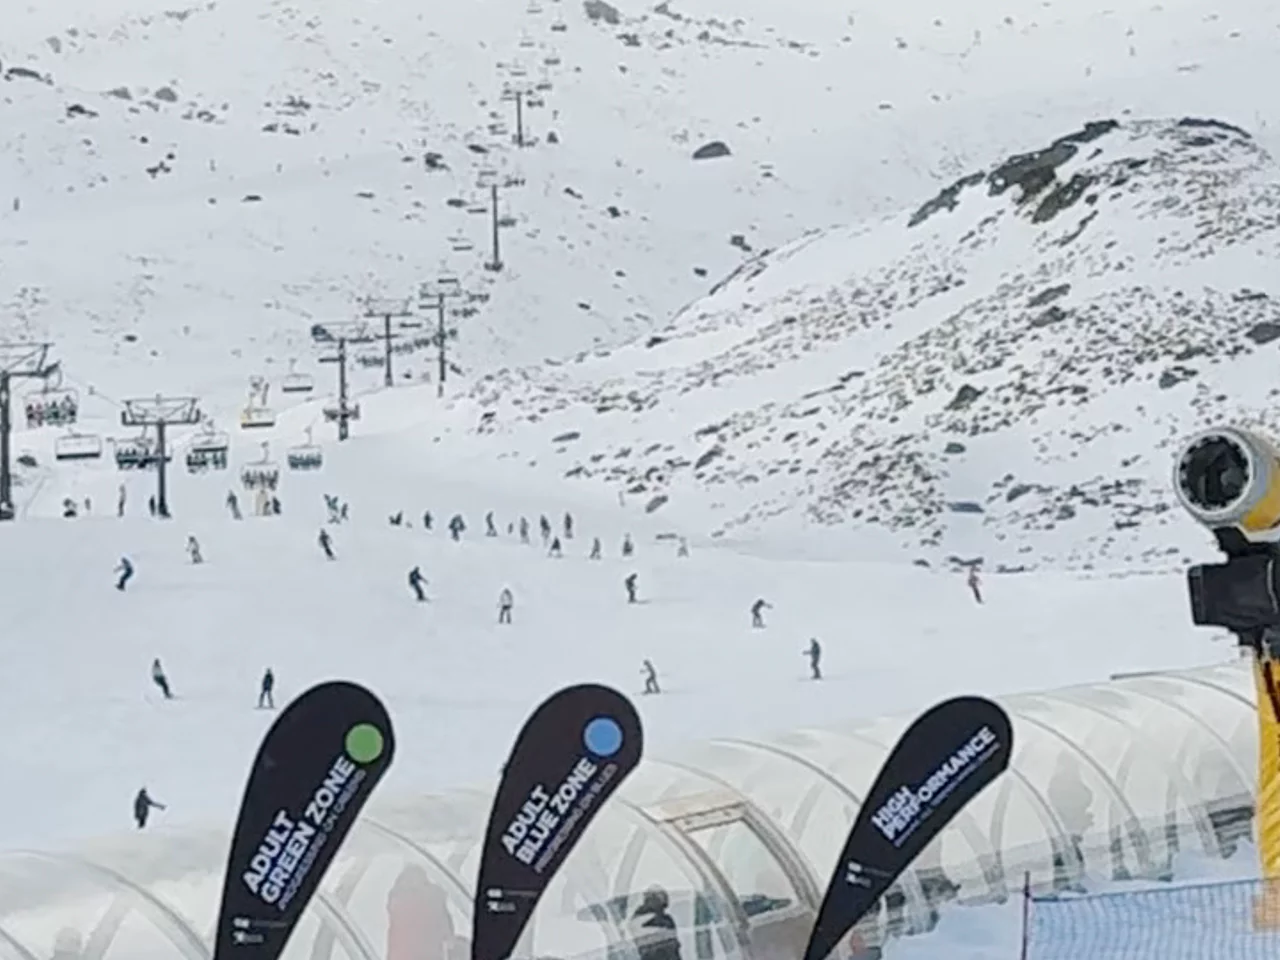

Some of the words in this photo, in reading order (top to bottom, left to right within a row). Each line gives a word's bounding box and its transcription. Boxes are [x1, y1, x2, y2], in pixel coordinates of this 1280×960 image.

[260, 821, 317, 903] GREEN
[304, 755, 356, 825] ZONE
[501, 784, 550, 855] ADULT
[514, 809, 560, 865] BLUE
[549, 757, 598, 815] ZONE
[871, 785, 914, 827] HIGH
[883, 725, 997, 840] PERFORMANCE
[243, 809, 295, 893] ADULT
